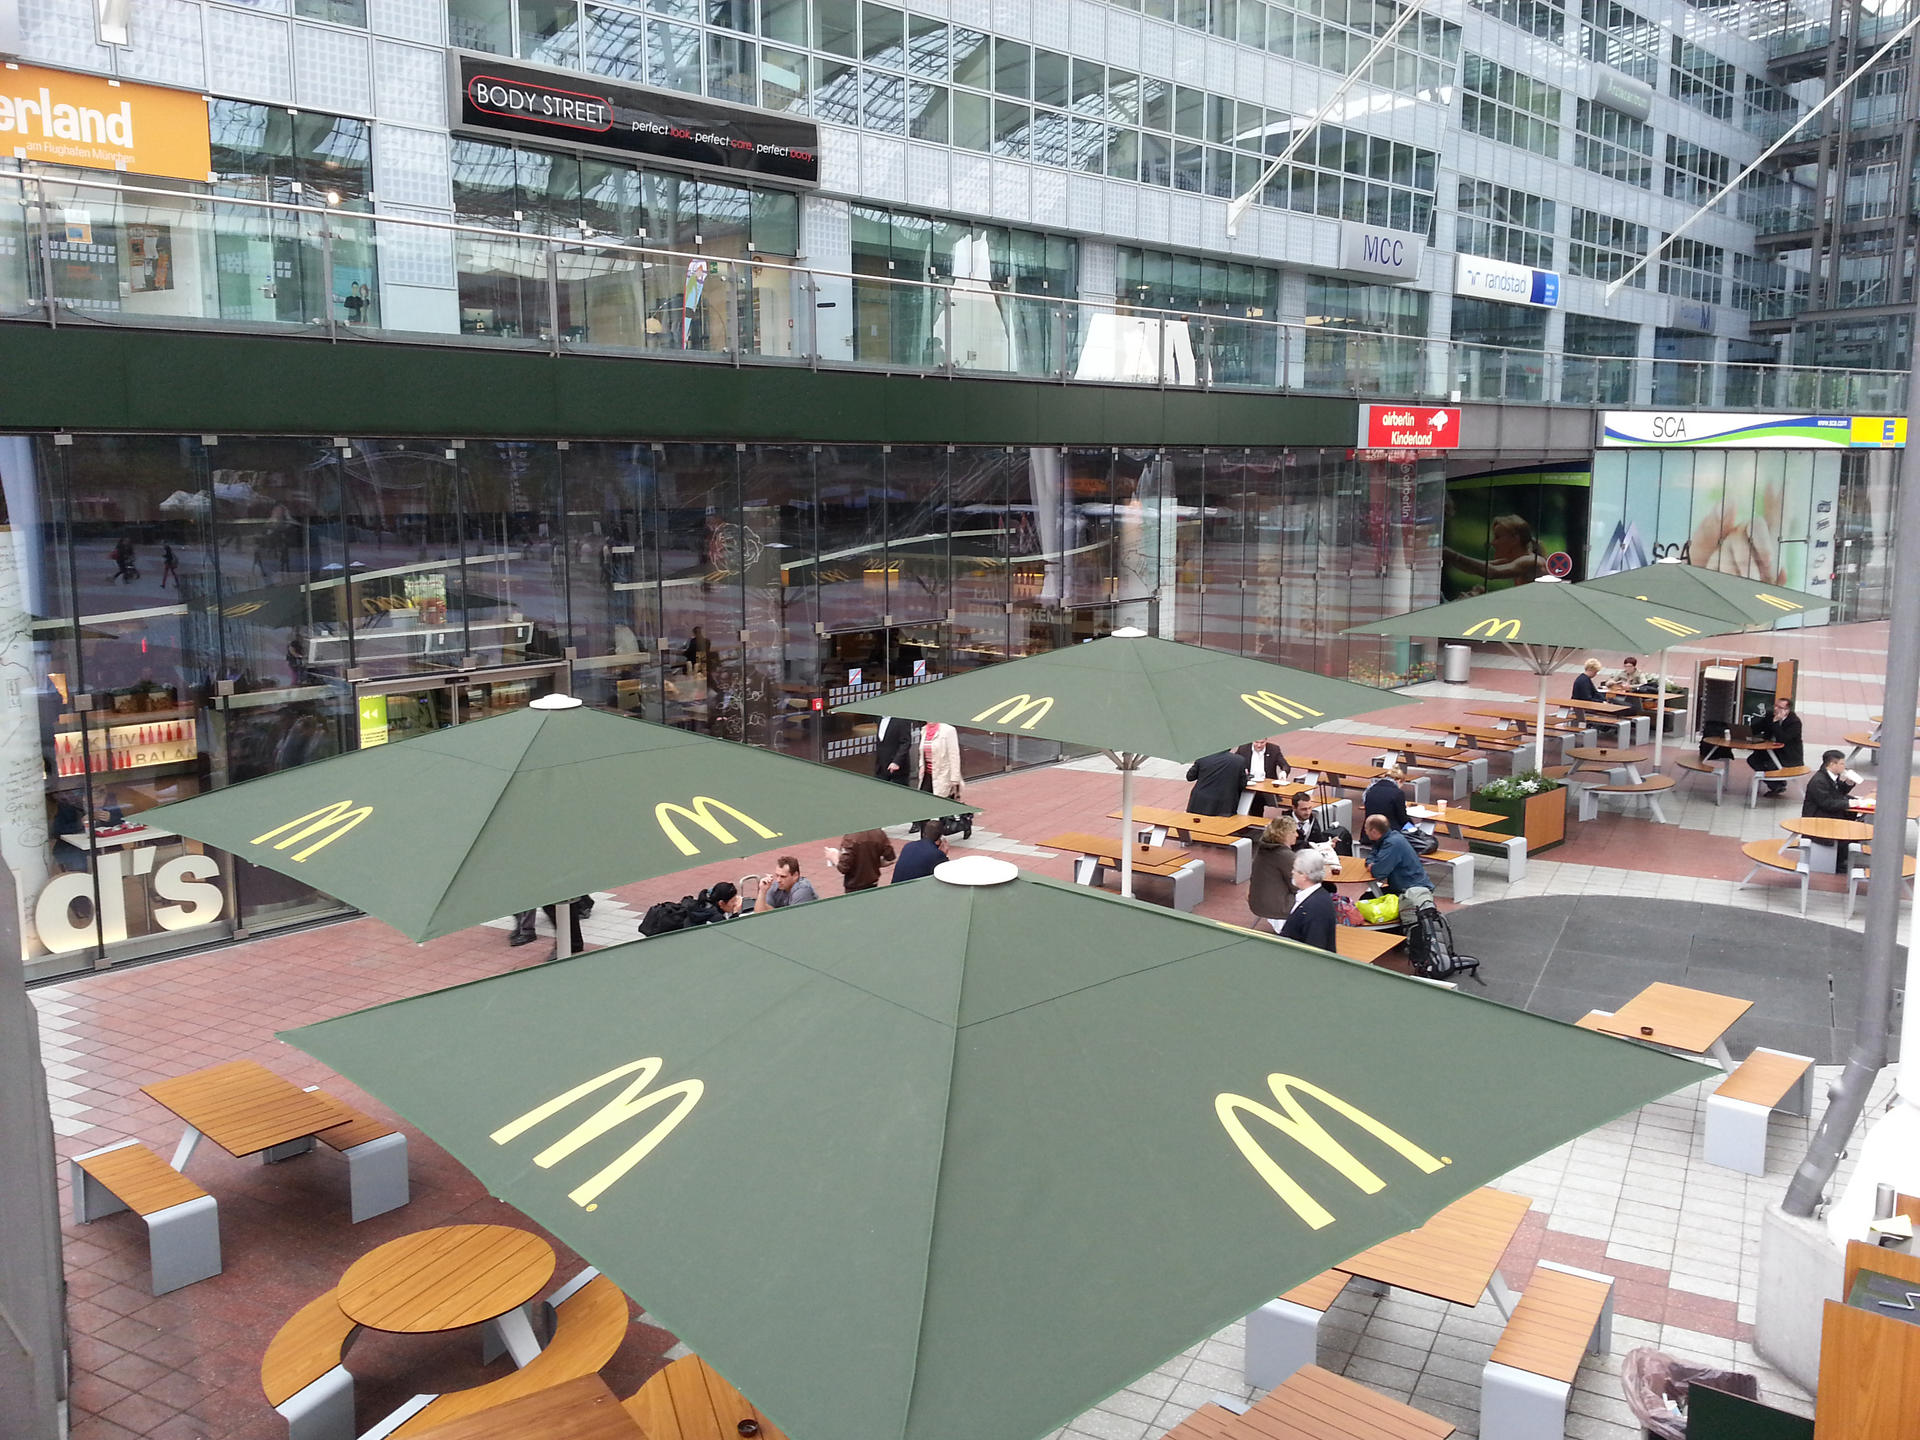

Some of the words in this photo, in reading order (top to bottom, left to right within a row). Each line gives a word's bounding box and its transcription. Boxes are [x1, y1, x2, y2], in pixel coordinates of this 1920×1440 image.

[477, 83, 536, 112] BODY
[543, 95, 605, 124] STREET
[631, 121, 668, 136] perfect
[695, 132, 729, 147] perfect
[756, 143, 789, 158] perfect
[26, 142, 42, 152] am
[44, 142, 91, 158] Flughafen
[92, 148, 135, 164] München
[1363, 235, 1404, 267] MCC
[1485, 270, 1527, 294] randstad
[1382, 411, 1415, 426] airberlin
[1652, 416, 1687, 438] SCA
[1391, 431, 1433, 446] Kinderland
[1652, 542, 1692, 565] SCA
[15, 845, 224, 960] d's
